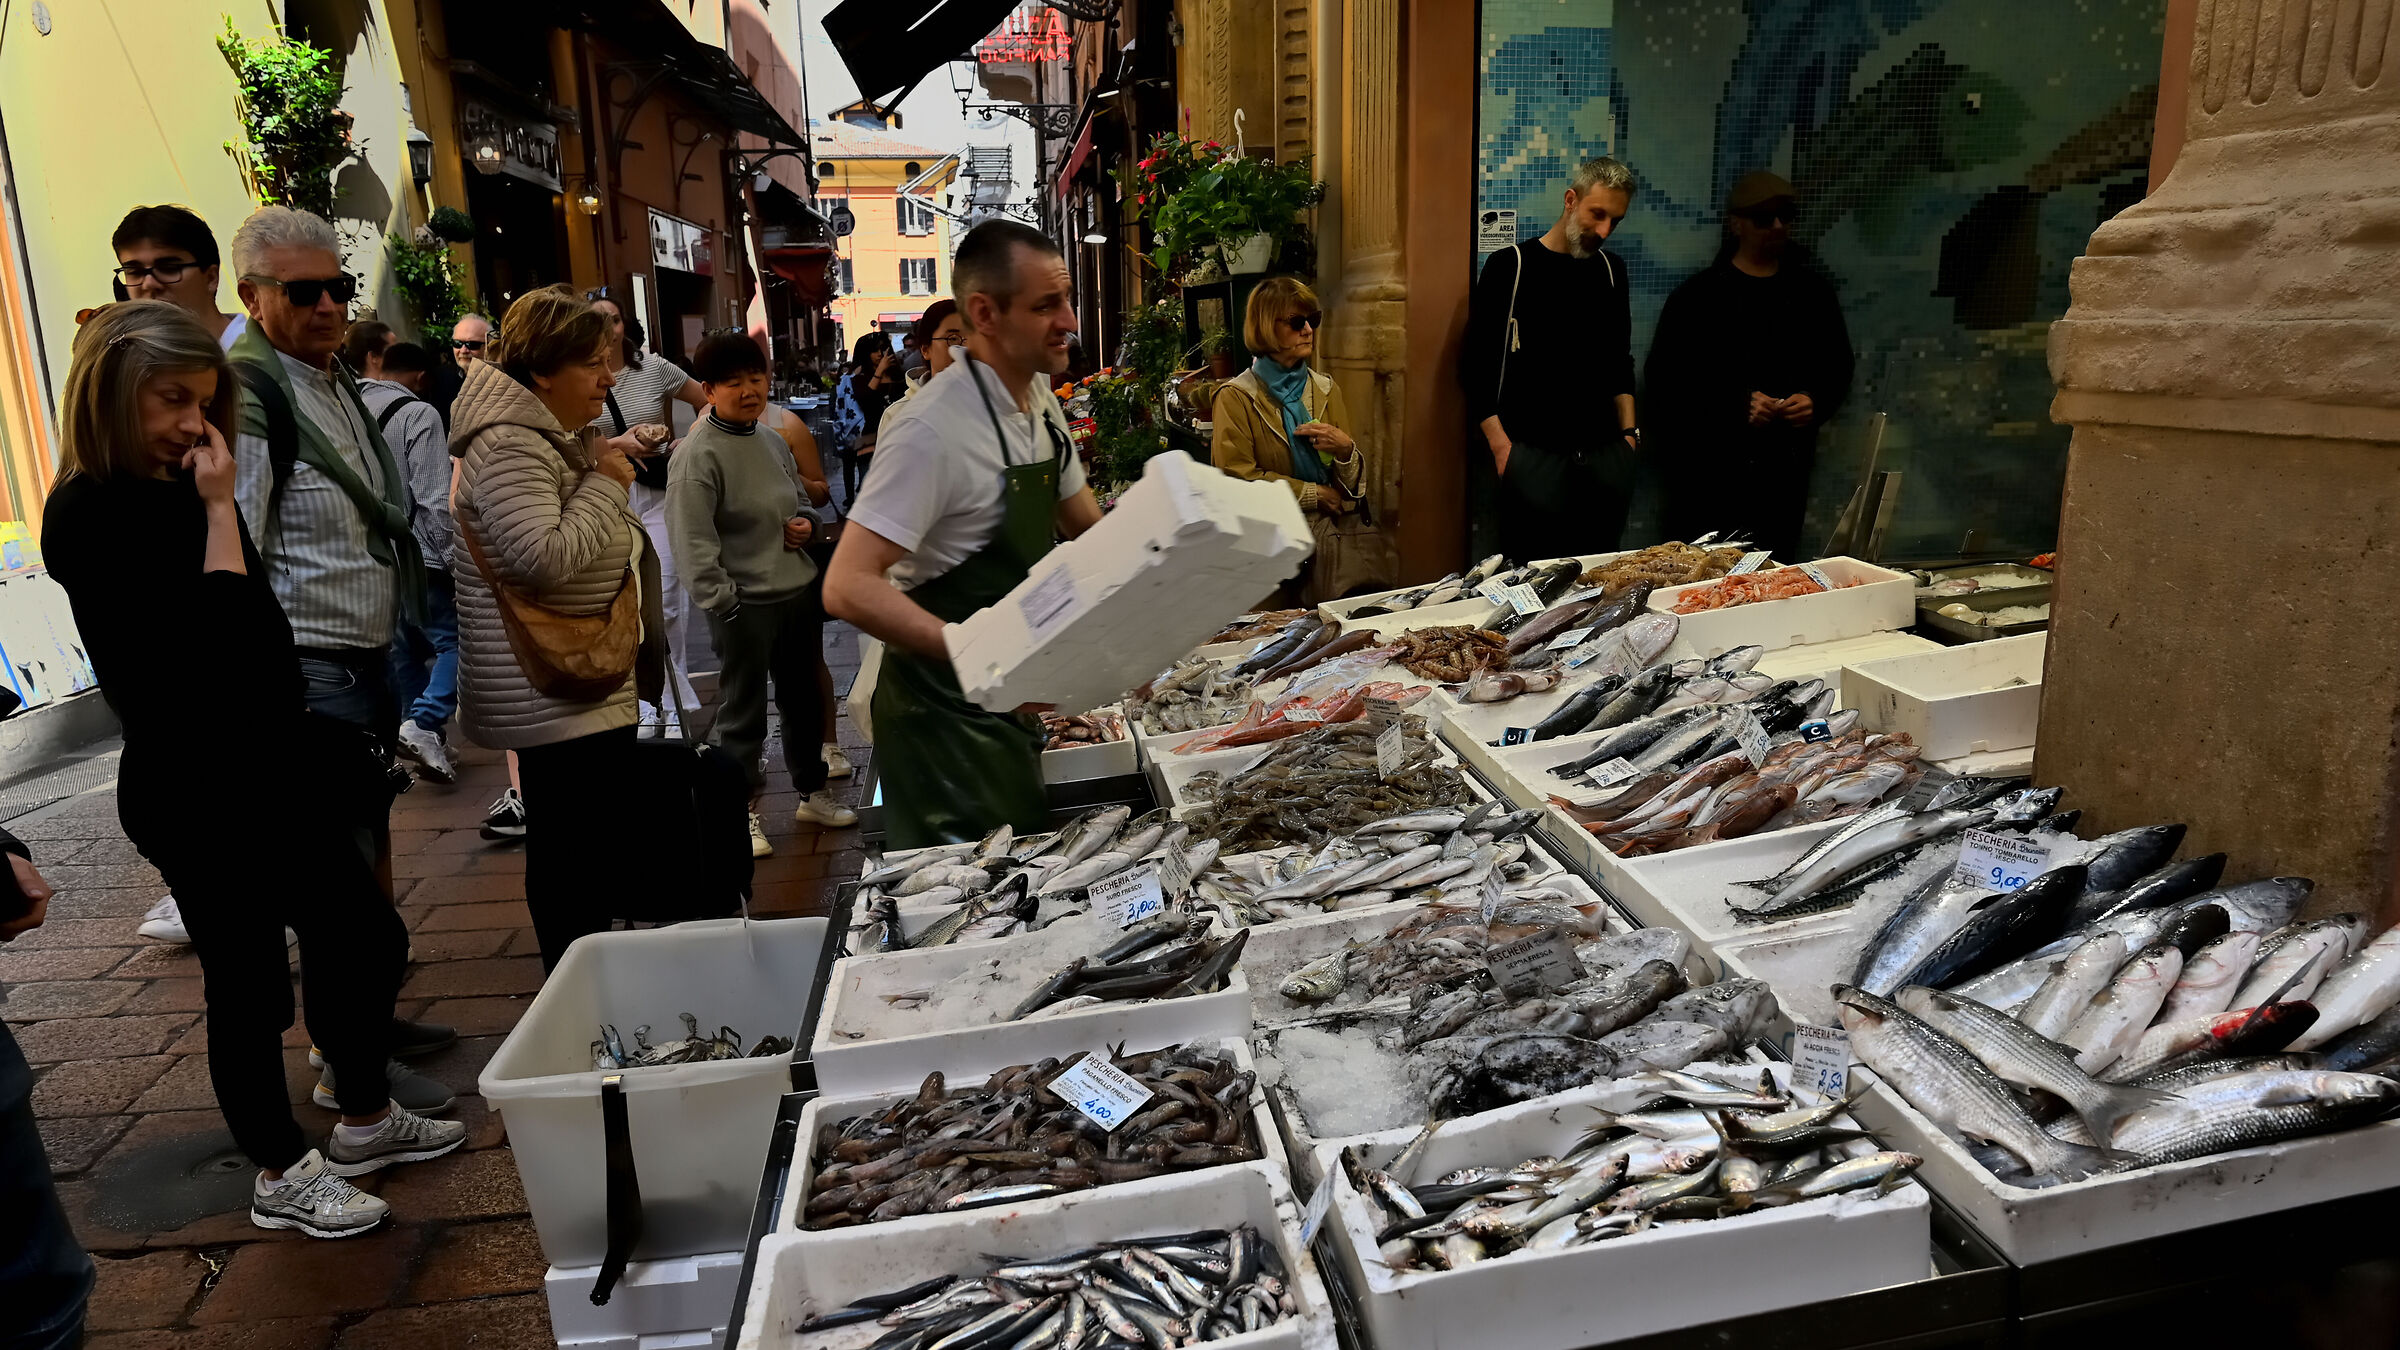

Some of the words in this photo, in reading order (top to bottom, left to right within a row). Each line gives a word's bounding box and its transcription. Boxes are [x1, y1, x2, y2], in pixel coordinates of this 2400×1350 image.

[1811, 727, 1821, 735] C
[1966, 830, 2017, 850] PESCHERIA
[1995, 848, 2039, 864] TOMBARELLO
[1091, 876, 1130, 897] PESCHERIA
[1990, 867, 2027, 889] 9,00
[1105, 891, 1121, 901] SURO
[1121, 883, 1142, 896] FRESCO
[1127, 900, 1156, 920] 3,00
[1485, 941, 1534, 966] PESCHERIA
[1528, 948, 1554, 964] FRESCA
[1796, 1025, 1830, 1039] PESCHERIA
[1086, 1056, 1125, 1085] PESCHERIA
[1081, 1067, 1112, 1090] PAGANELLO
[1110, 1086, 1132, 1104] FRESCO
[1084, 1098, 1112, 1119] 4,00
